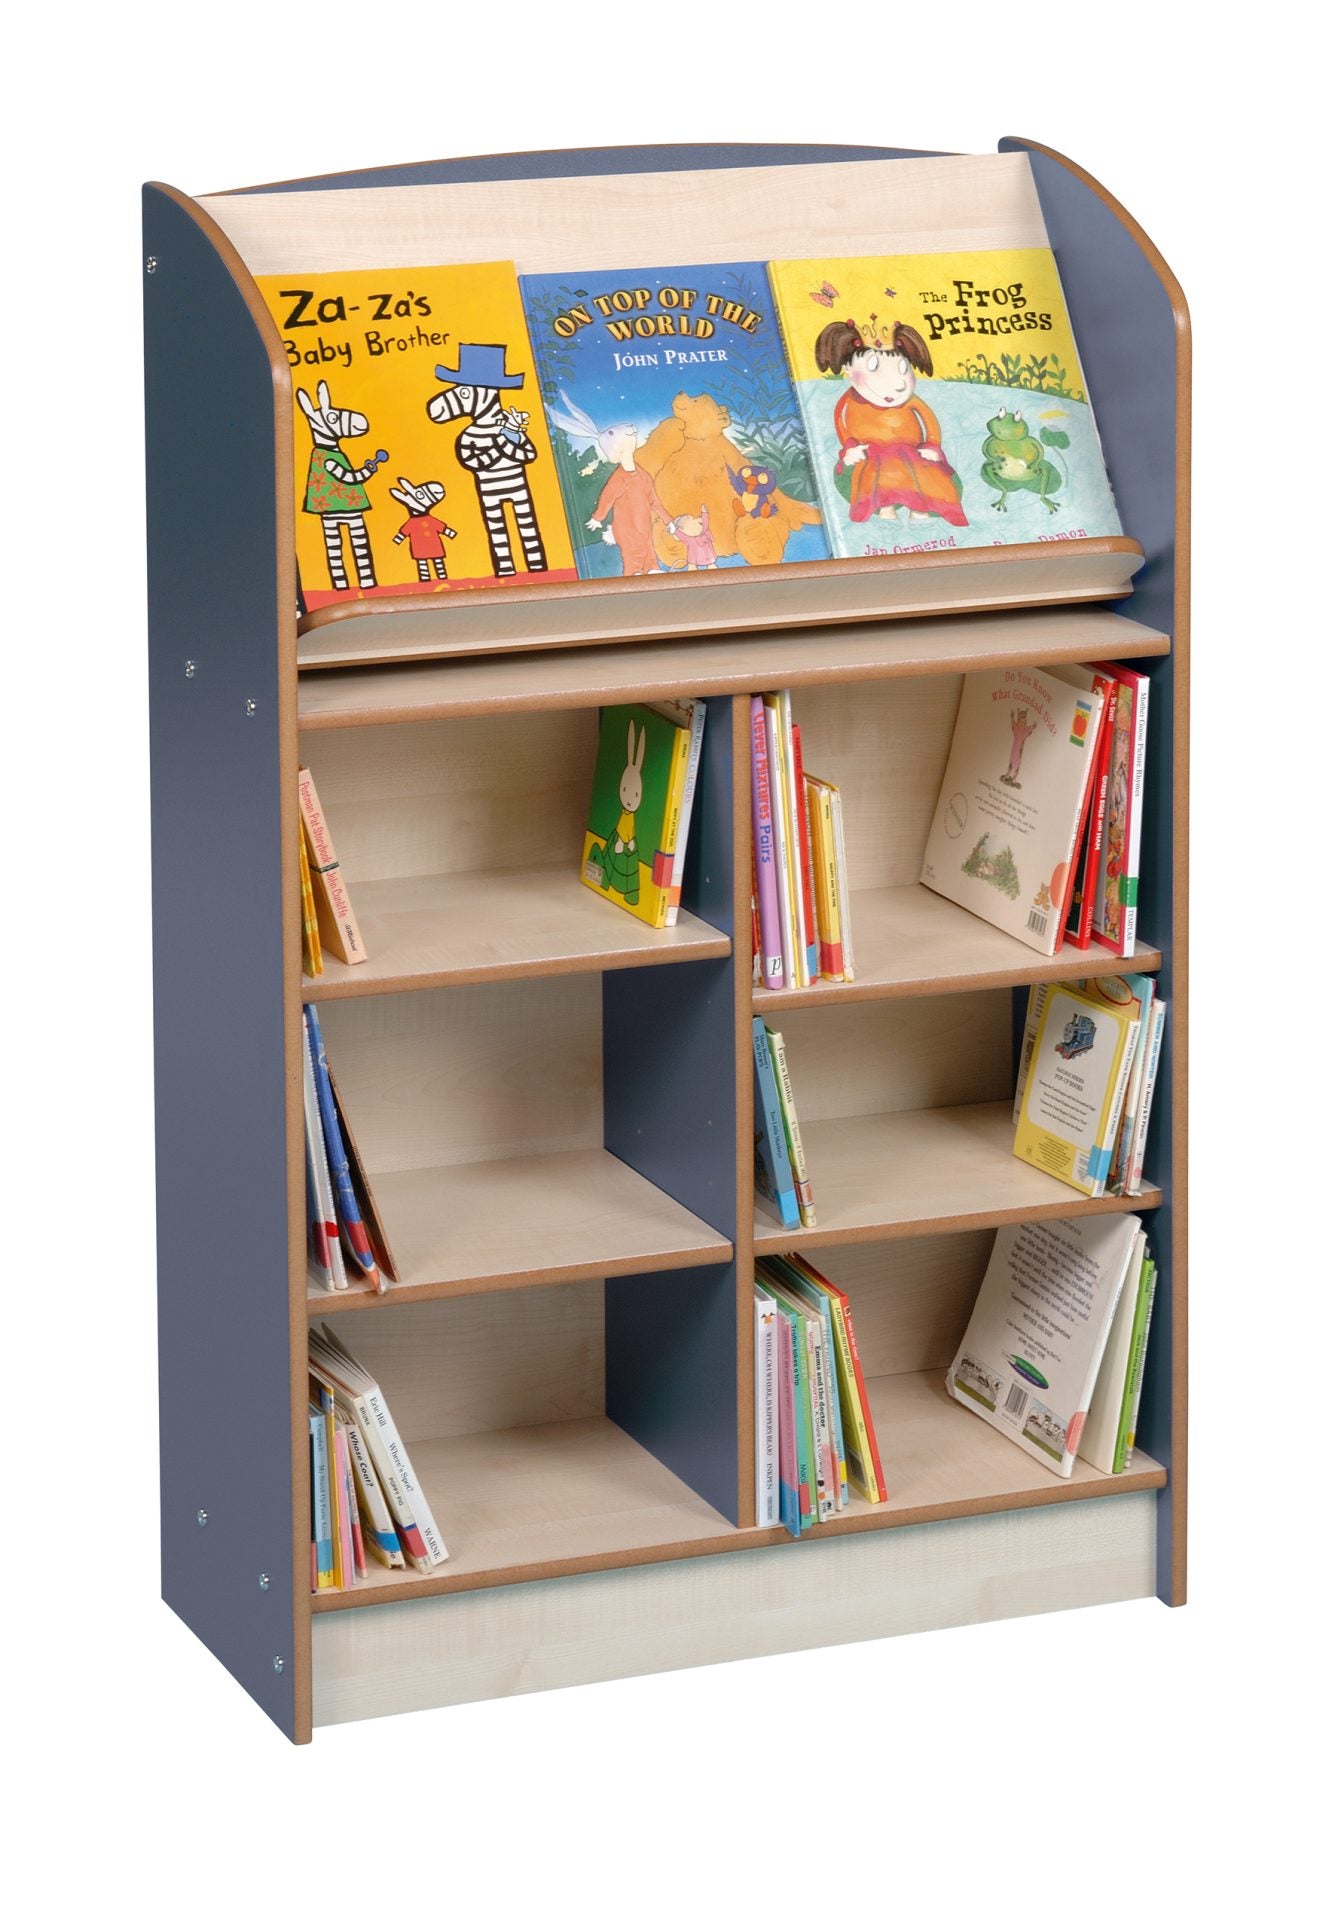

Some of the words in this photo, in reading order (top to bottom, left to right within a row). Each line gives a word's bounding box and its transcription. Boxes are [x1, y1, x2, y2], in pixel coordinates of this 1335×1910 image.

[919, 292, 948, 303] The
[953, 280, 1027, 309] Frog
[553, 304, 593, 337] ON
[593, 288, 652, 317] TOP
[658, 288, 697, 310] OF
[706, 294, 763, 334] THE
[605, 315, 715, 342] WORLD
[283, 337, 352, 367] Baby
[364, 326, 450, 356] Brother
[664, 350, 728, 365] PRATER
[864, 544, 888, 556] Jan
[893, 536, 956, 554] Ormerod
[1138, 692, 1147, 718] Mother
[1137, 719, 1146, 742] Goose
[1135, 743, 1145, 768] Picture
[1099, 775, 1108, 798] GREEN
[1133, 769, 1143, 797] Rhymes
[298, 781, 318, 814] Postman
[1097, 799, 1106, 819] EGGS
[308, 813, 321, 827] Pat
[312, 827, 333, 865] Storybook
[759, 825, 773, 863] Pairs
[1094, 832, 1103, 851] HAM
[326, 870, 341, 889] John
[331, 888, 350, 918] Cunliffe
[1084, 906, 1094, 938] COLLINS
[1126, 909, 1135, 942] TEMPLAR
[778, 1051, 785, 1066] am
[782, 1074, 793, 1104] Rabbit
[814, 1346, 823, 1371] Emma
[816, 1372, 824, 1387] and
[359, 1406, 371, 1427] BRUNA
[369, 1396, 382, 1414] Eric
[376, 1413, 388, 1427] Hill
[818, 1401, 827, 1428] doctor
[348, 1430, 364, 1462] Whose
[359, 1461, 374, 1489] Coat?
[387, 1442, 406, 1474] Where's
[399, 1472, 414, 1494] Spot?
[423, 1527, 442, 1560] WARNE
